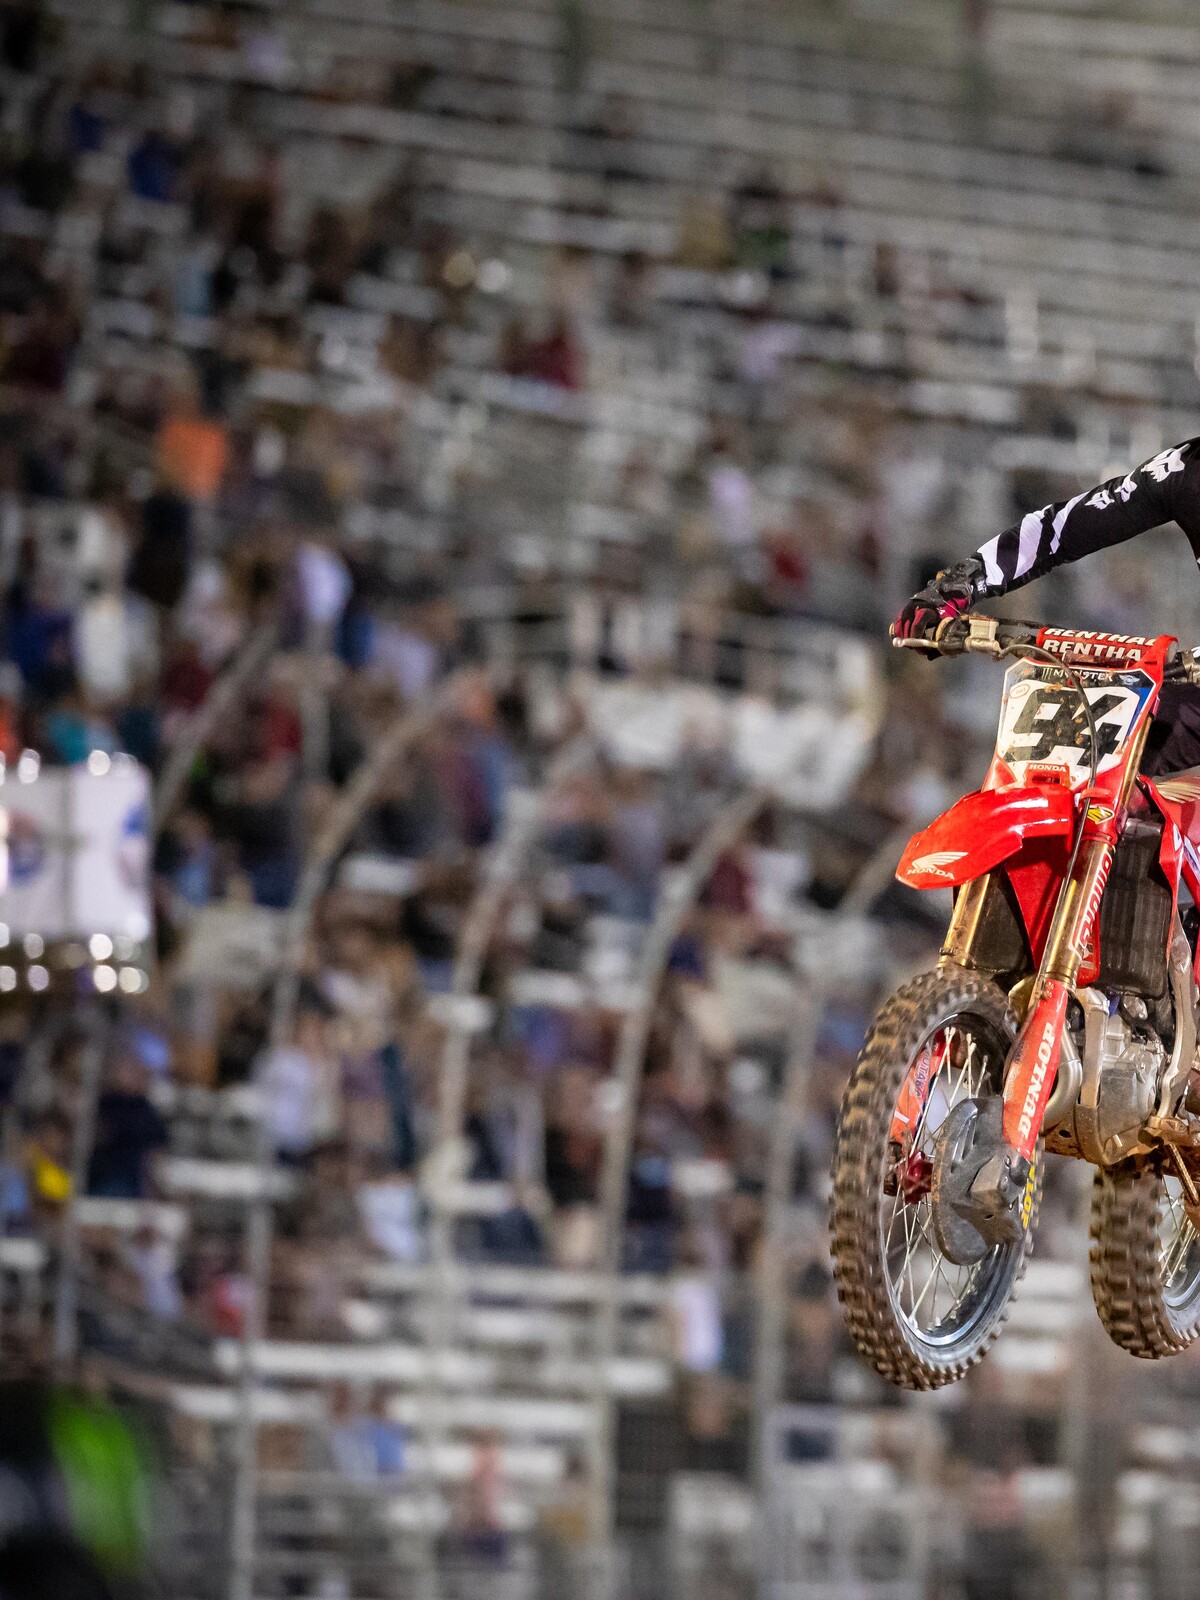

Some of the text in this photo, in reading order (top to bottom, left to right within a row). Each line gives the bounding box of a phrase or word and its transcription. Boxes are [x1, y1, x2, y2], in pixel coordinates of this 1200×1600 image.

[1042, 639, 1142, 662] RENTHA
[1003, 688, 1128, 767] 94
[1029, 763, 1067, 773] HONDA
[906, 867, 956, 880] HONDA
[1017, 1022, 1056, 1140] DUNLOP
